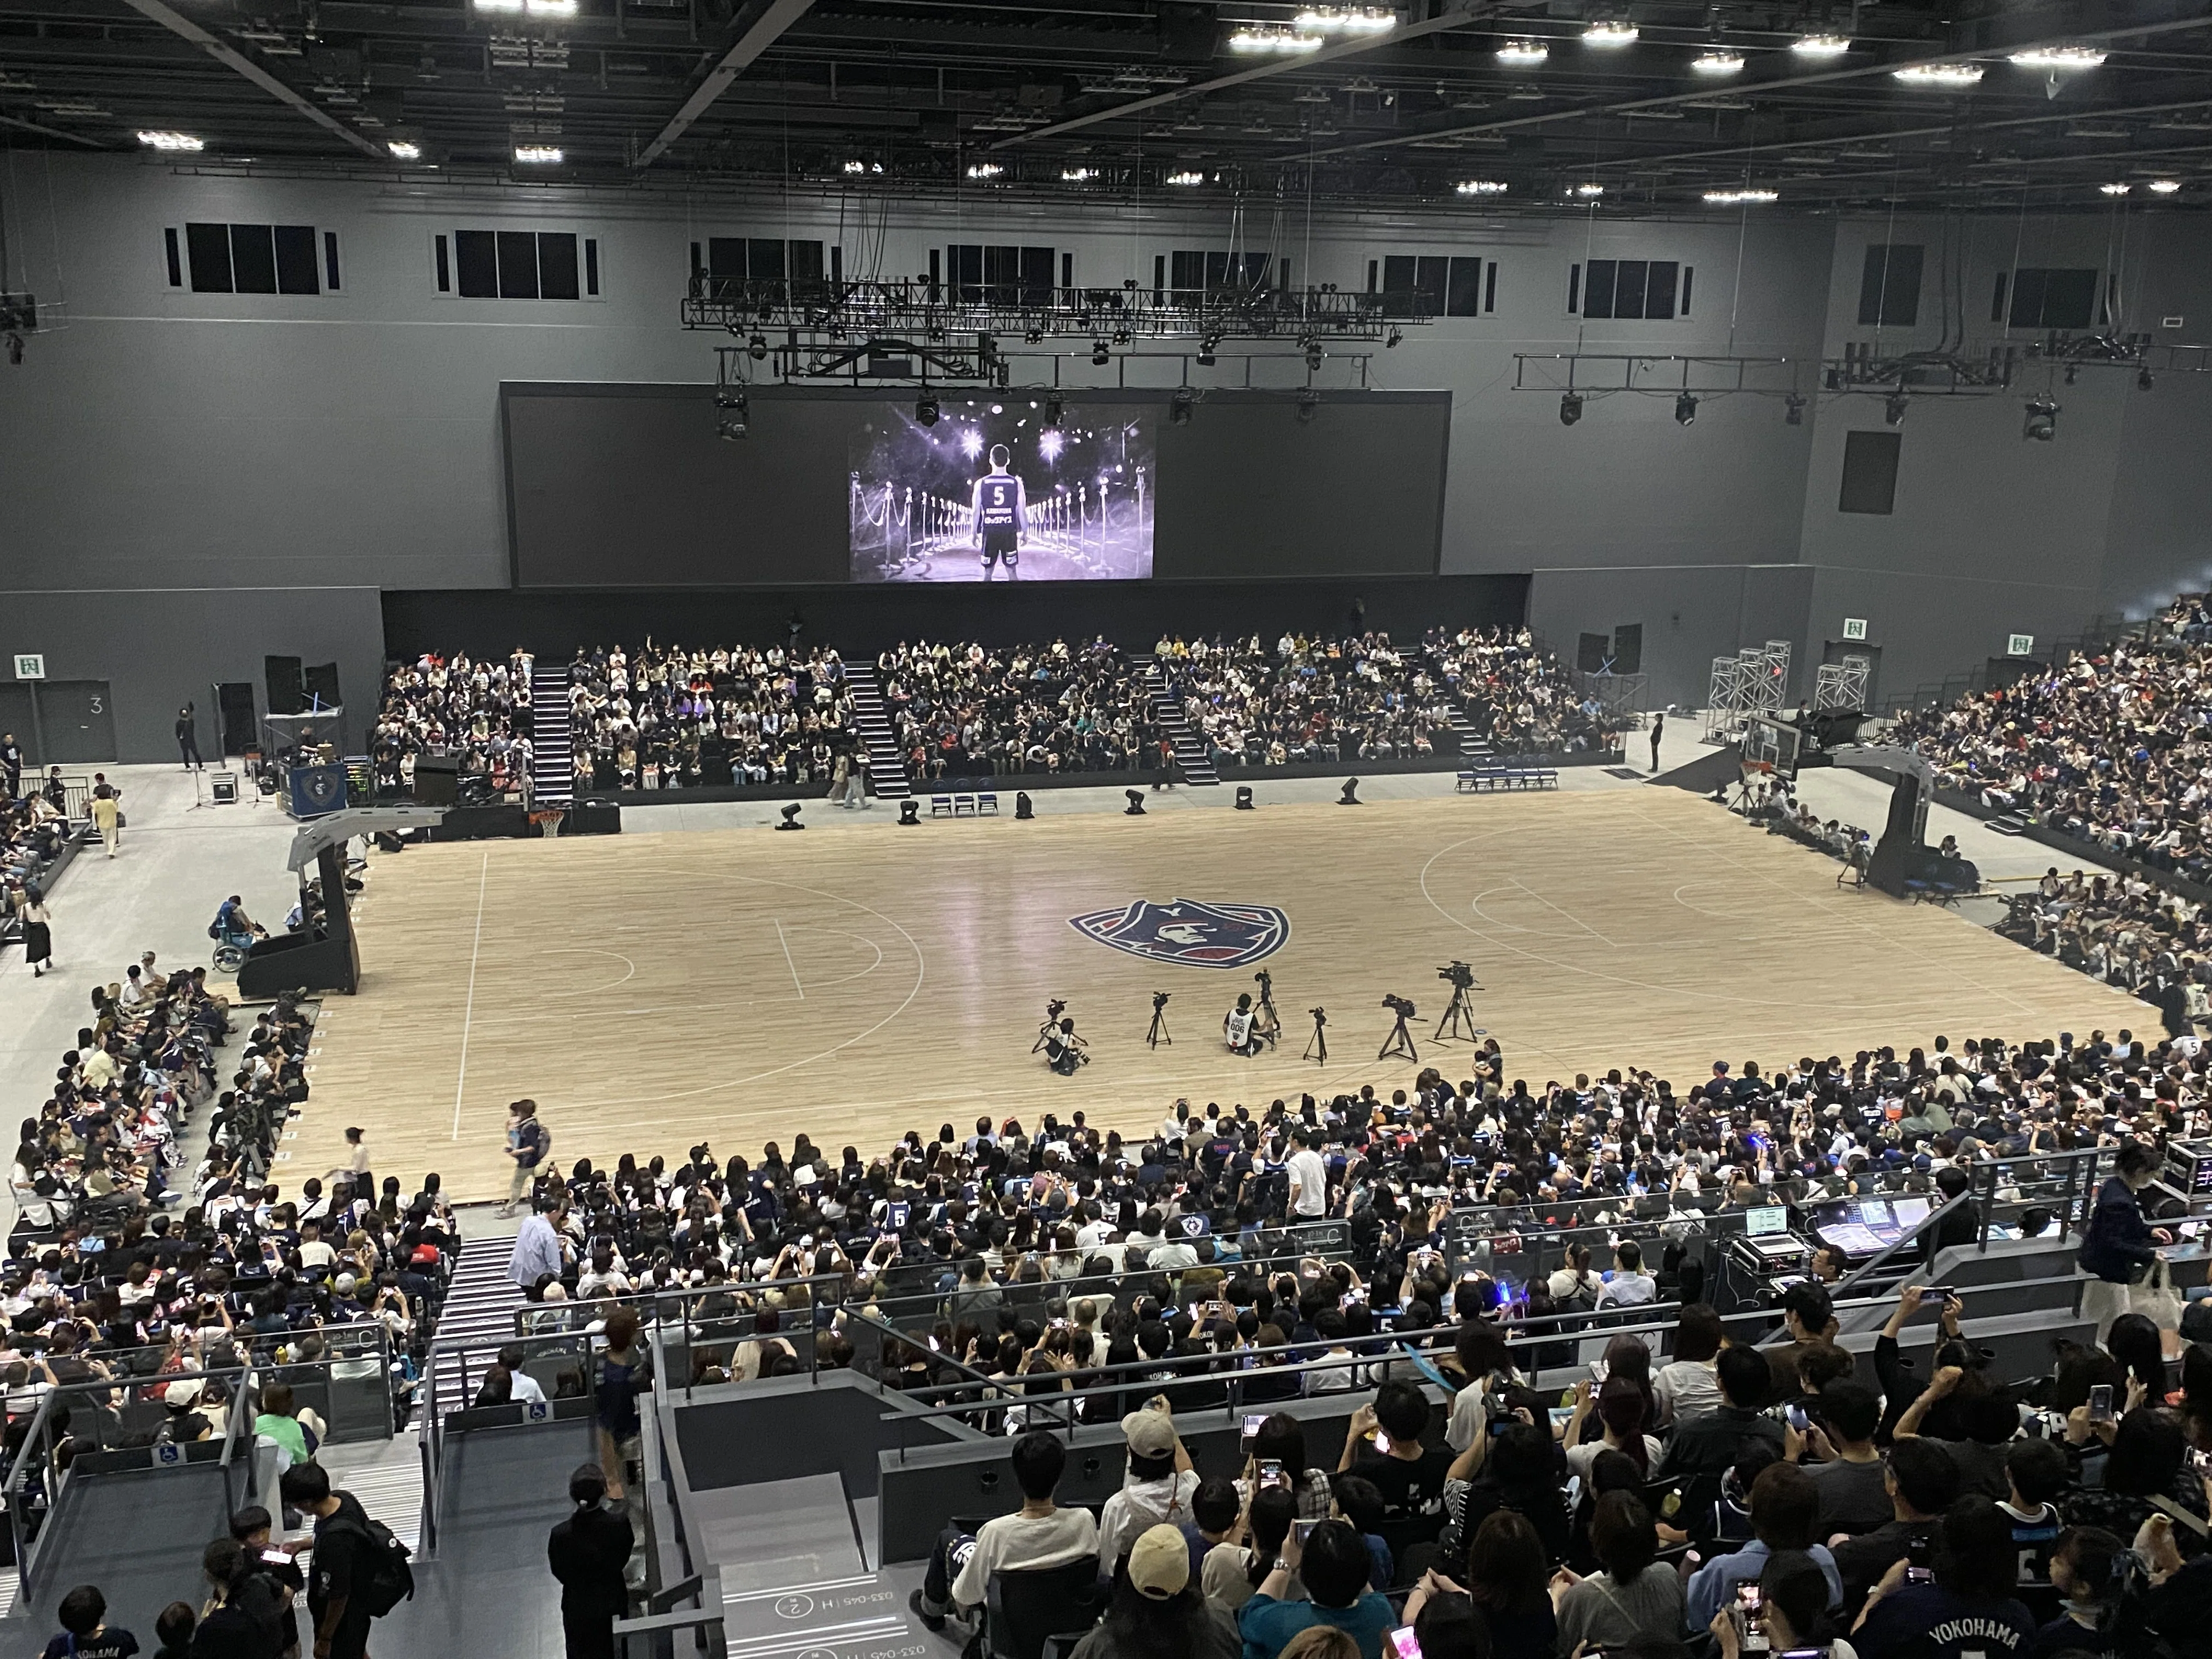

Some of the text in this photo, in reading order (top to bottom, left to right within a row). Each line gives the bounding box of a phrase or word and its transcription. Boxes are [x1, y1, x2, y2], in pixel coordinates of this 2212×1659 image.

[994, 486, 1005, 505] 5
[90, 697, 103, 714] 3
[1231, 1023, 1245, 1034] 006
[2191, 1042, 2198, 1053] 5
[894, 1210, 906, 1227] 5
[1460, 1215, 1471, 1231] C
[1327, 1228, 1339, 1244] C
[359, 1330, 373, 1348] C
[790, 1604, 800, 1614] 2
[822, 1592, 893, 1610] 033-045 H
[1929, 1618, 2020, 1650] YOKOHAMA
